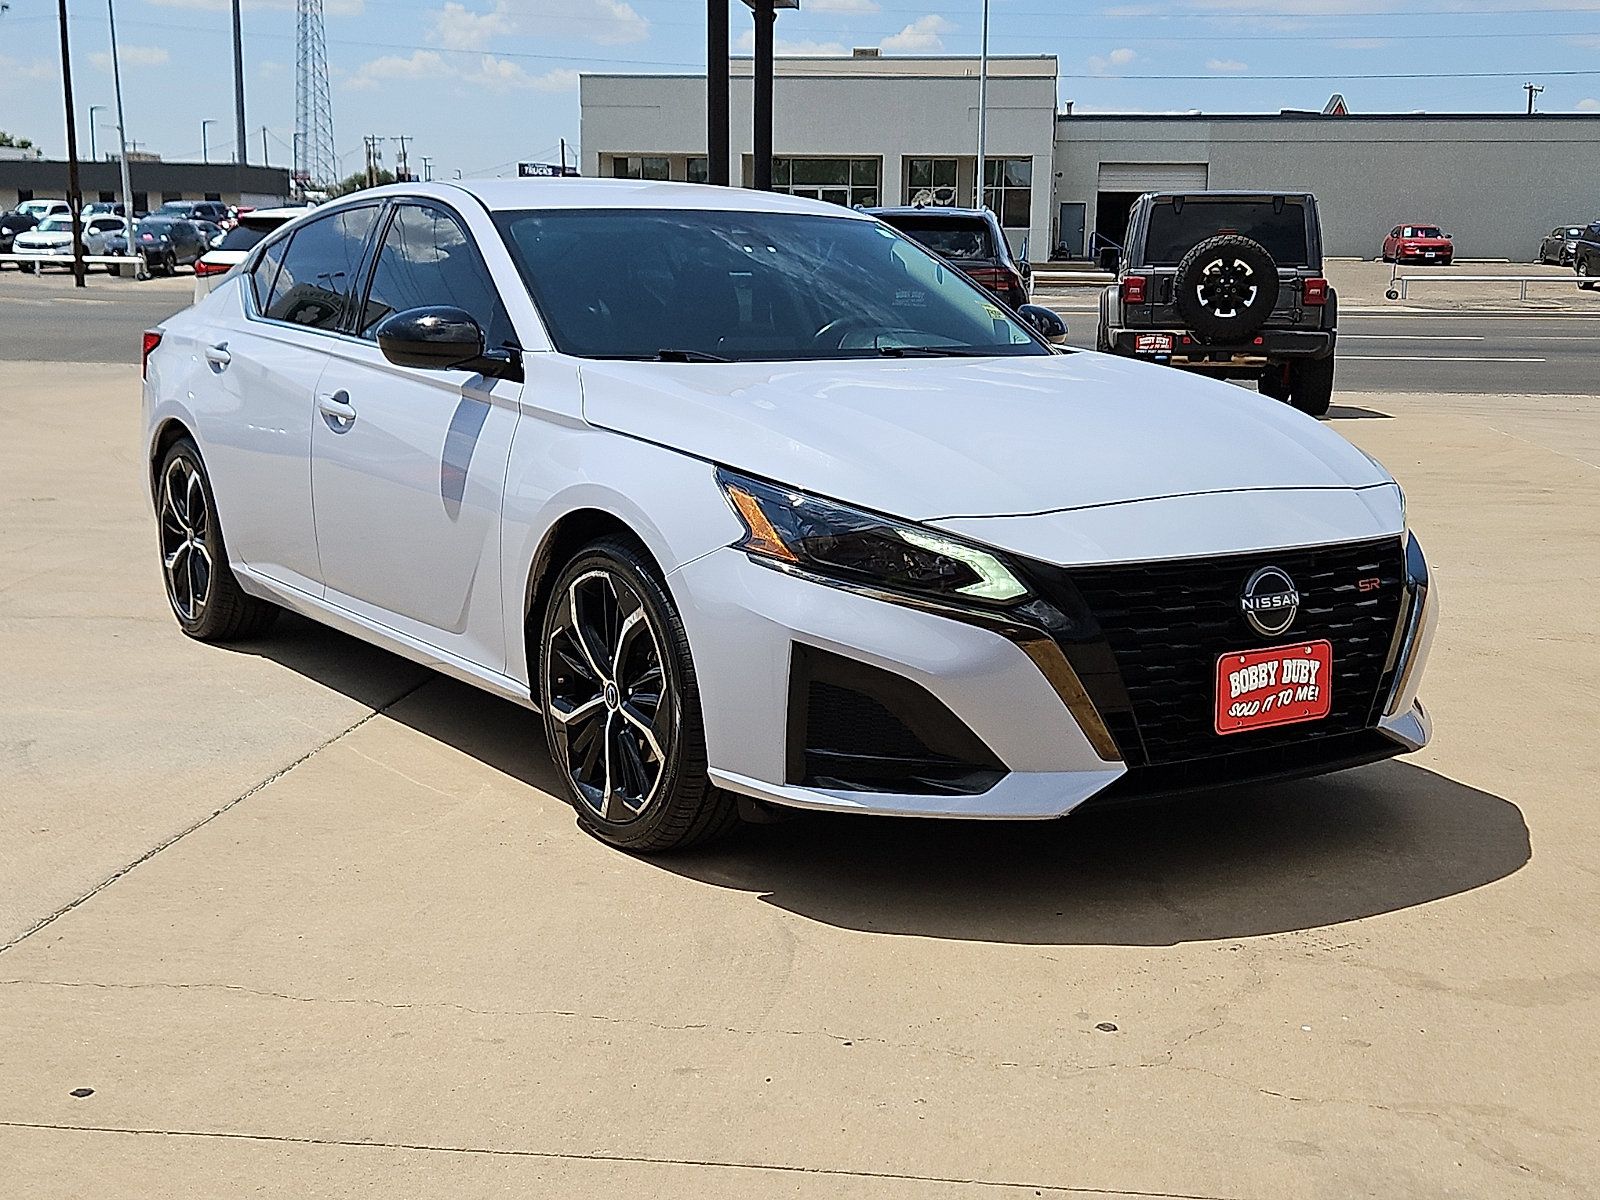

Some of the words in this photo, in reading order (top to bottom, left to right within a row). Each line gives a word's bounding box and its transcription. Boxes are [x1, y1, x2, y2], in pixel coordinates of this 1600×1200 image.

[524, 166, 553, 175] TRUCKS
[1358, 577, 1380, 592] SR
[1241, 593, 1299, 610] NISSAN
[1229, 659, 1278, 698] BOBBY
[1282, 658, 1320, 684] DUBY
[1228, 700, 1260, 716] SOLD
[1261, 695, 1276, 713] IT
[1277, 688, 1293, 707] TO
[1294, 685, 1319, 702] ME!
